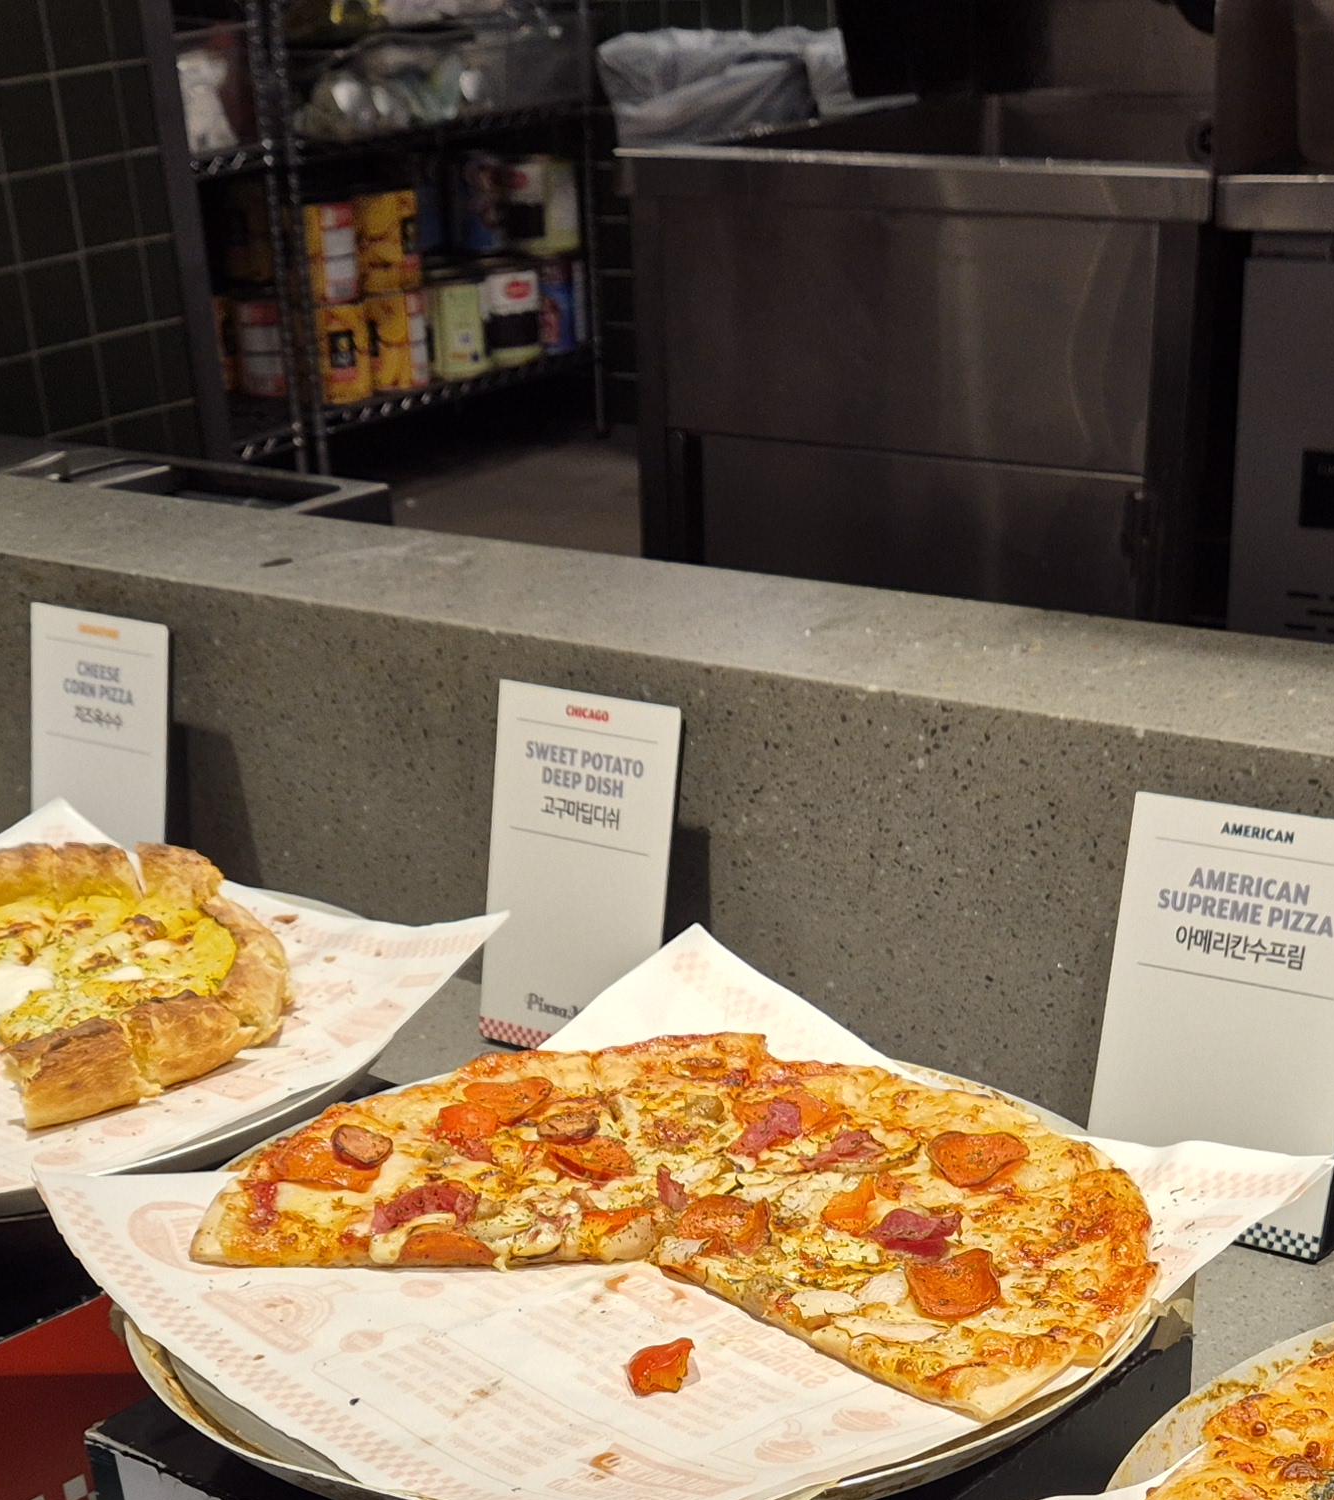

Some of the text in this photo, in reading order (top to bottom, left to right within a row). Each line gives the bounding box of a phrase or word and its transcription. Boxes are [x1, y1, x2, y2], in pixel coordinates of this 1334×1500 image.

[77, 661, 119, 682] CHEESE
[99, 684, 134, 705] PIZZA
[566, 704, 610, 722] CHICAGO
[525, 740, 645, 778] SWEET POTATO
[541, 766, 624, 799] DEEP DISH
[541, 796, 620, 831] 고구마딥디쉬
[1220, 822, 1295, 844] AMERICAN
[1189, 867, 1310, 906] AMERICAN
[1158, 888, 1334, 938] SUPREME PIZZA
[1176, 925, 1306, 971] 아메리칸수프림
